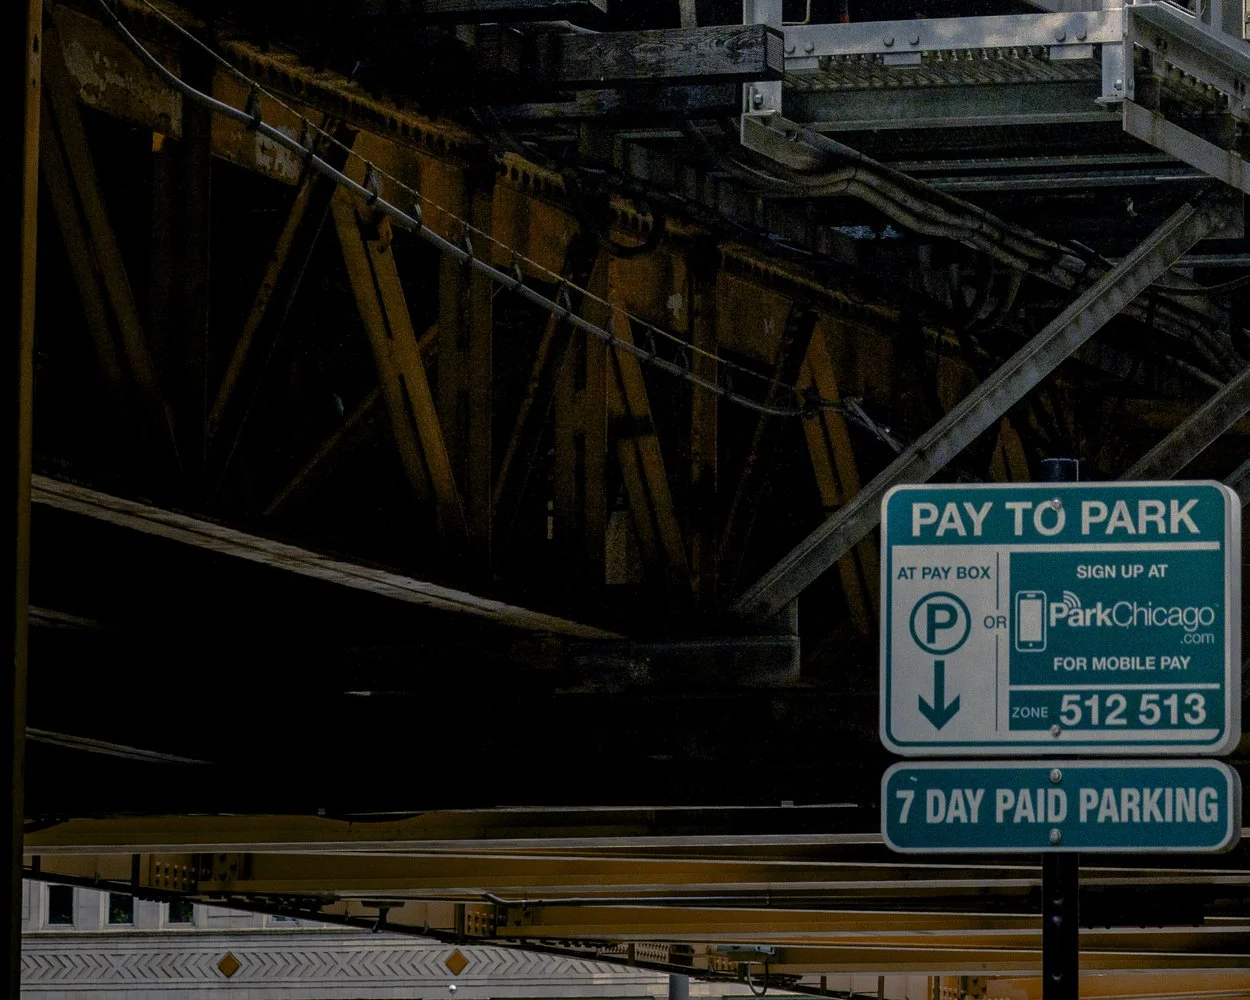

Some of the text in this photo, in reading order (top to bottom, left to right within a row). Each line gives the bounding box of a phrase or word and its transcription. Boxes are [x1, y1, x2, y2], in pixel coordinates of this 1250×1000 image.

[911, 499, 1200, 537] PAY TO PARK
[897, 566, 991, 580] AT PAY BOX
[1076, 564, 1168, 579] SIGN UP AT
[926, 603, 958, 644] P
[984, 616, 1007, 629] OR
[1049, 601, 1215, 632] ParkChicago
[1180, 632, 1215, 645] .com
[1053, 656, 1191, 671] FOR MOBILE PAY
[1012, 694, 1206, 726] ZONE 512 513
[896, 787, 1218, 823] 7 DAY PAID PARKING
